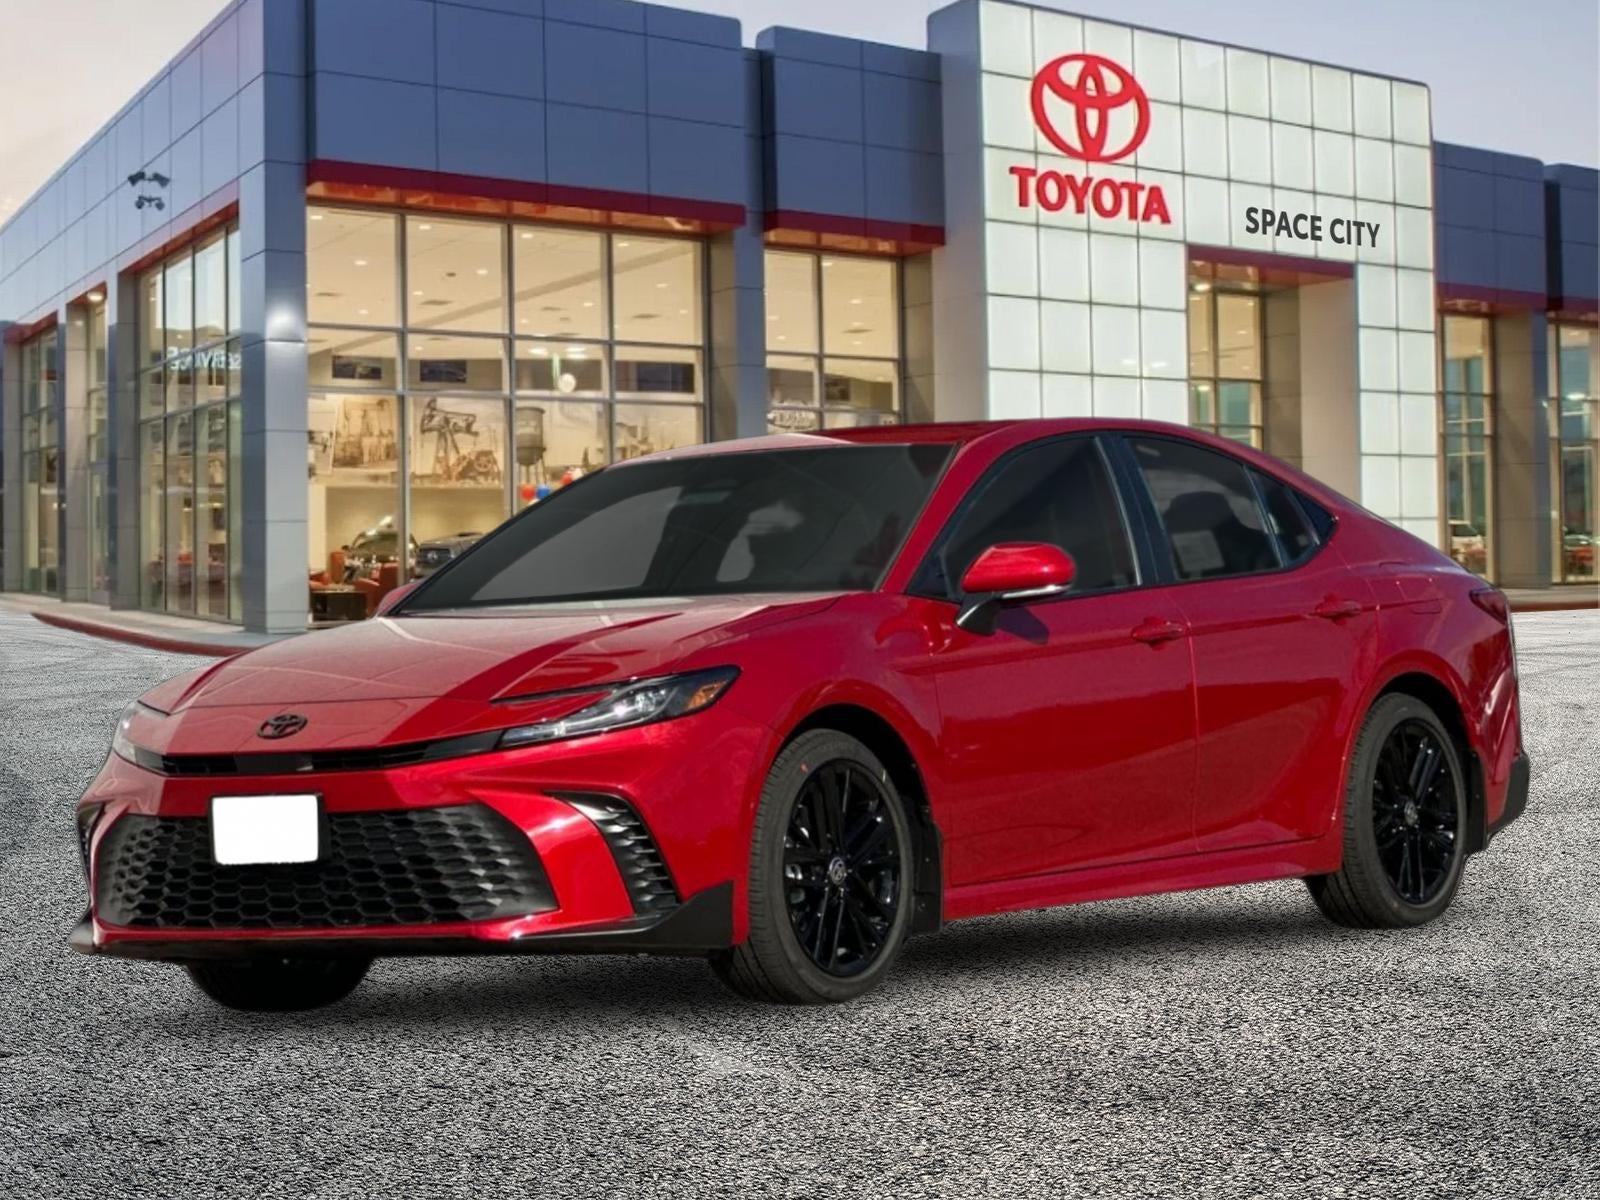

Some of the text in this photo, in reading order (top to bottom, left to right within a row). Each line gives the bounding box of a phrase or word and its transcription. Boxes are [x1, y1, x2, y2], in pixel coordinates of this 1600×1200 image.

[1009, 166, 1171, 224] TOYOTA
[1245, 207, 1380, 248] SPACE CITY
